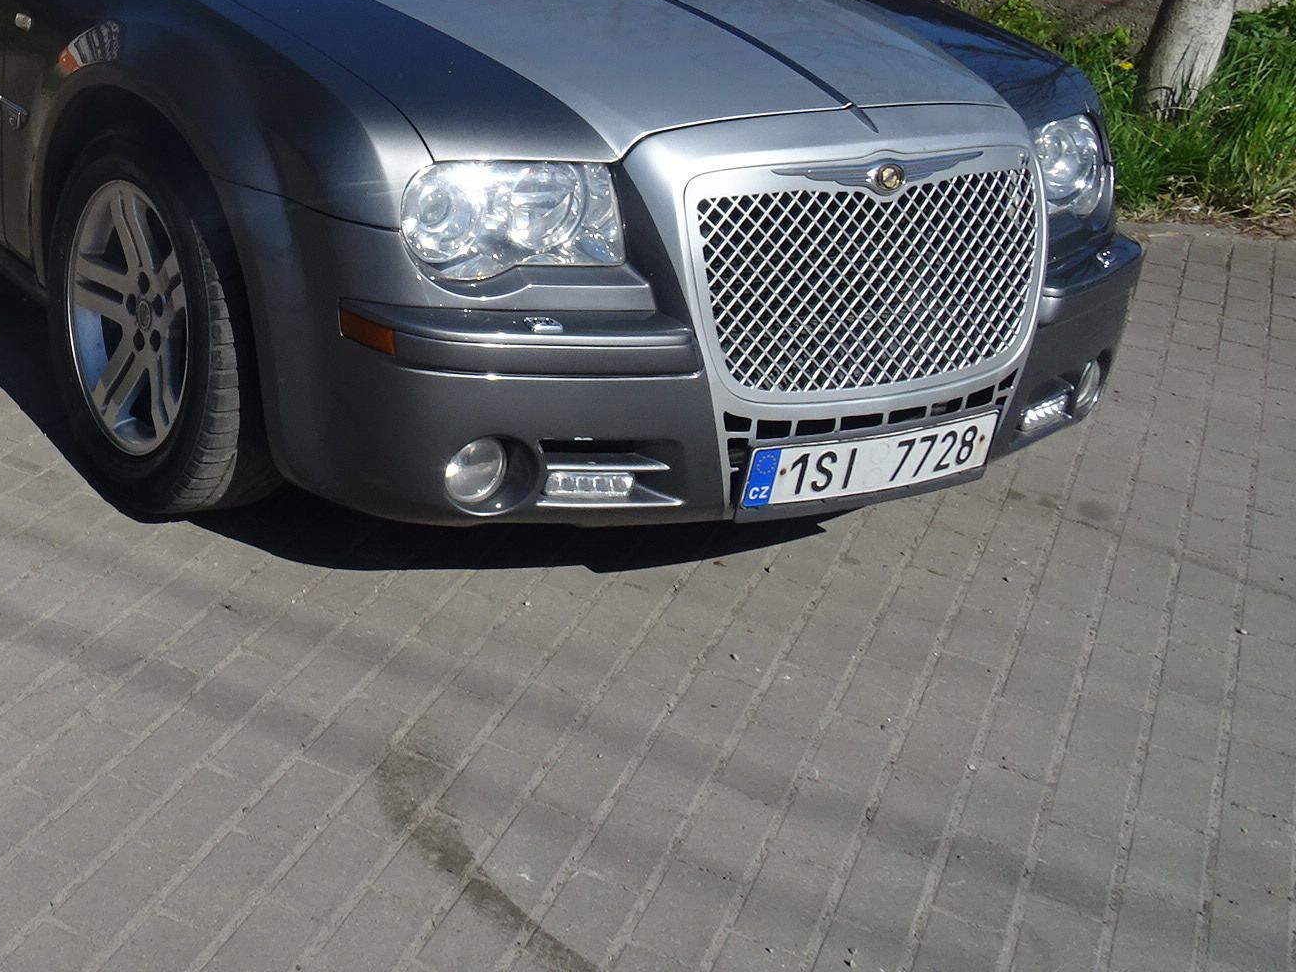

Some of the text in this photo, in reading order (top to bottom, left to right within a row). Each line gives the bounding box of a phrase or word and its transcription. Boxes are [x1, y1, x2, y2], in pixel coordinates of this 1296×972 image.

[790, 425, 979, 495] 1SI 7728
[748, 486, 770, 500] CZ
